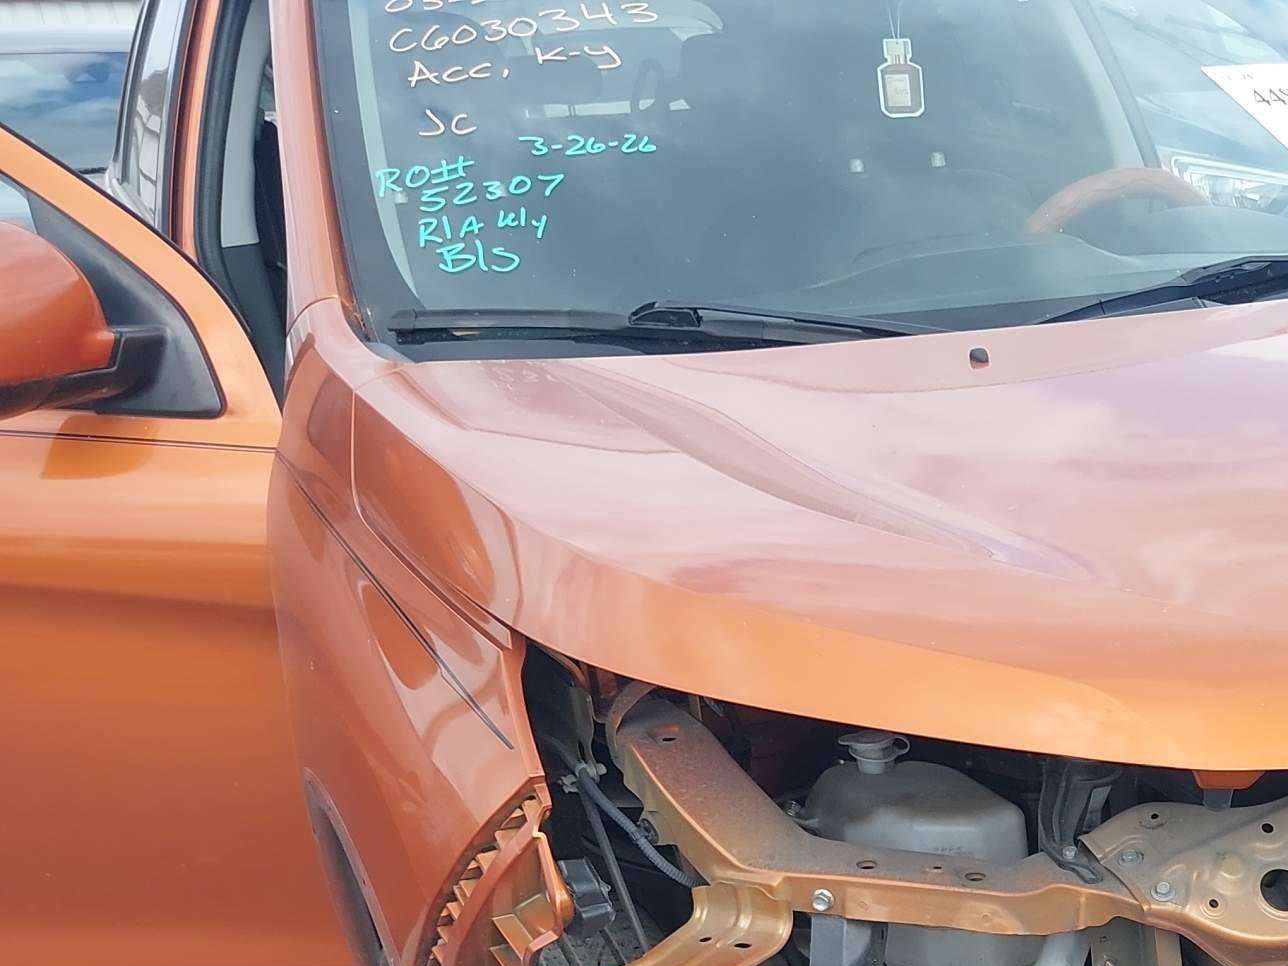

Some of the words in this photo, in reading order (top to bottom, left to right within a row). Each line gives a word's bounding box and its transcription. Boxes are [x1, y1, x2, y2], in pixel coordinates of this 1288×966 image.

[389, 2, 659, 52] C6030343
[517, 133, 657, 156] 3-26-26
[419, 173, 565, 211] 52307
